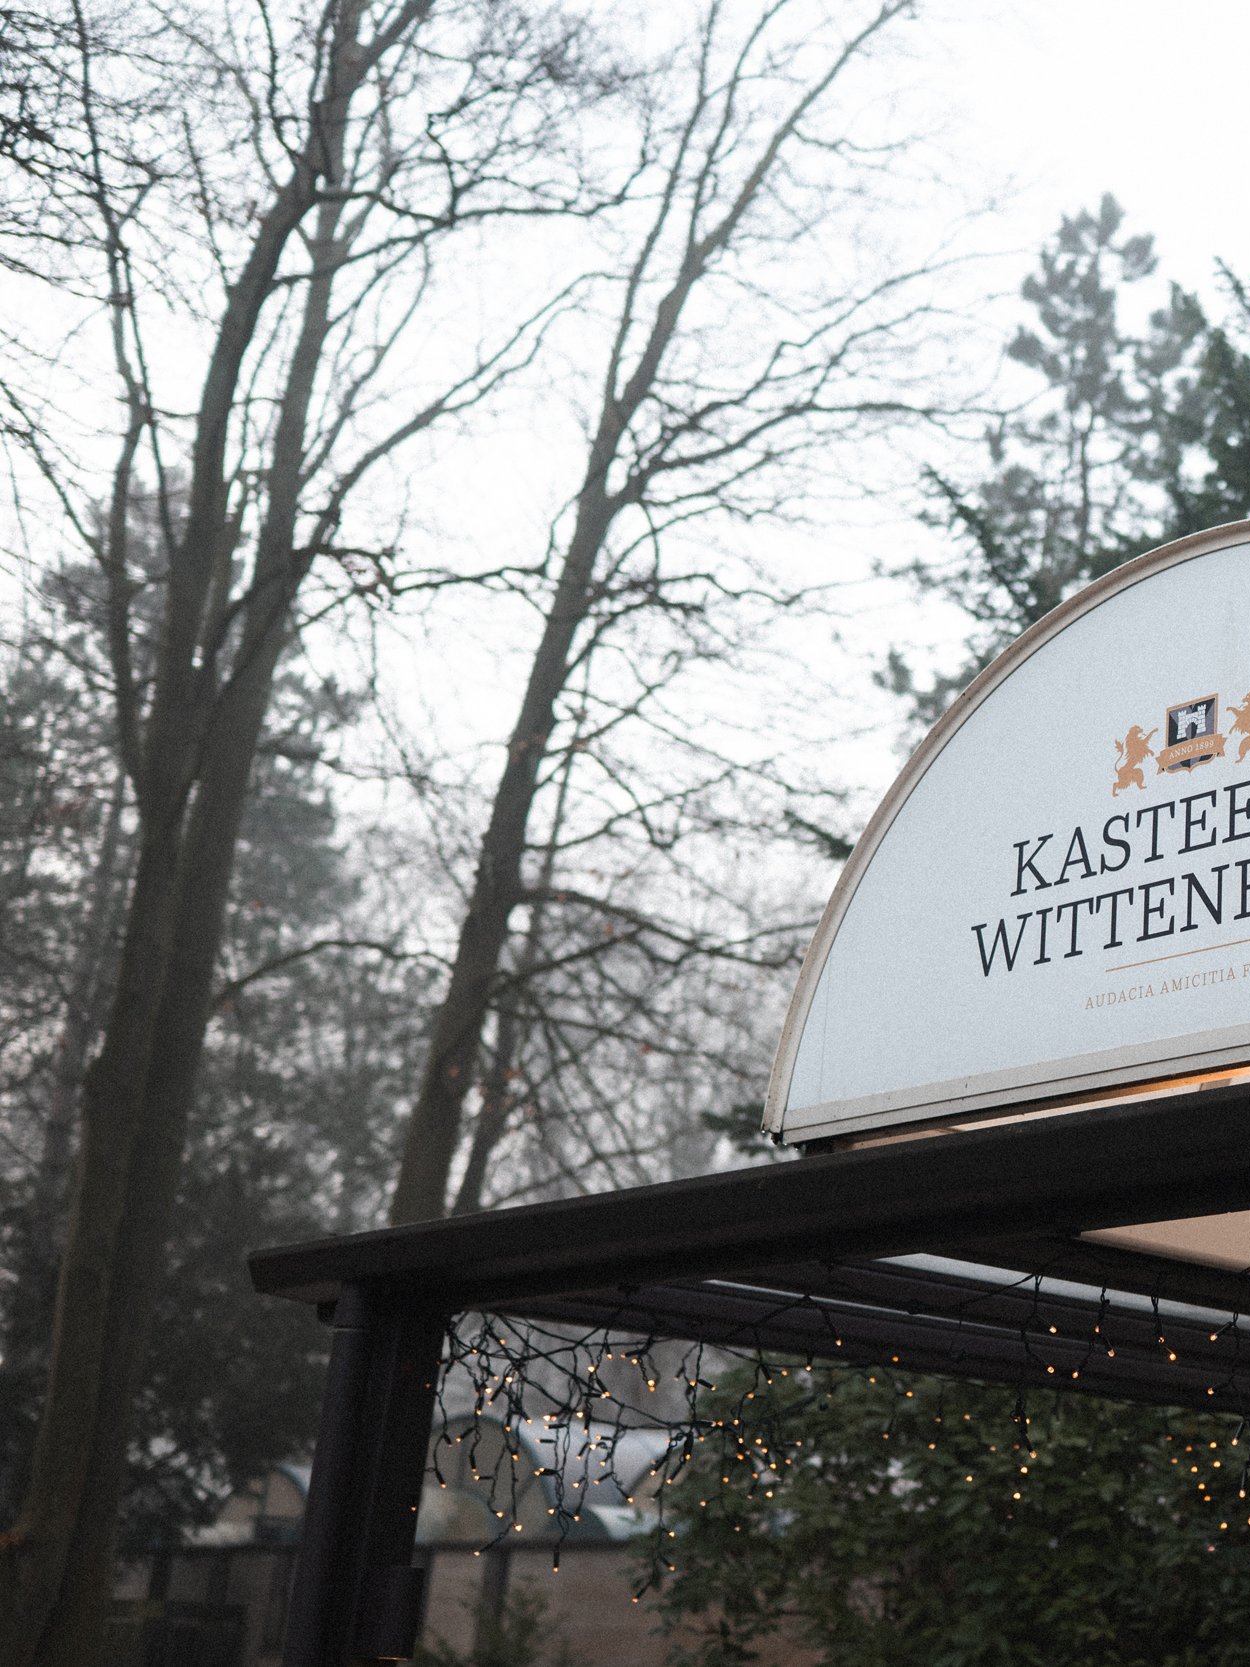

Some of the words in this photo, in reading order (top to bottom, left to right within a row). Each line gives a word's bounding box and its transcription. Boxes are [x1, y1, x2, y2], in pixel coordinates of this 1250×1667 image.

[1169, 745, 1193, 759] ANNO
[1195, 740, 1214, 751] 1899
[1084, 984, 1154, 1010] AUDACIA
[1160, 967, 1236, 995] AMICITIA
